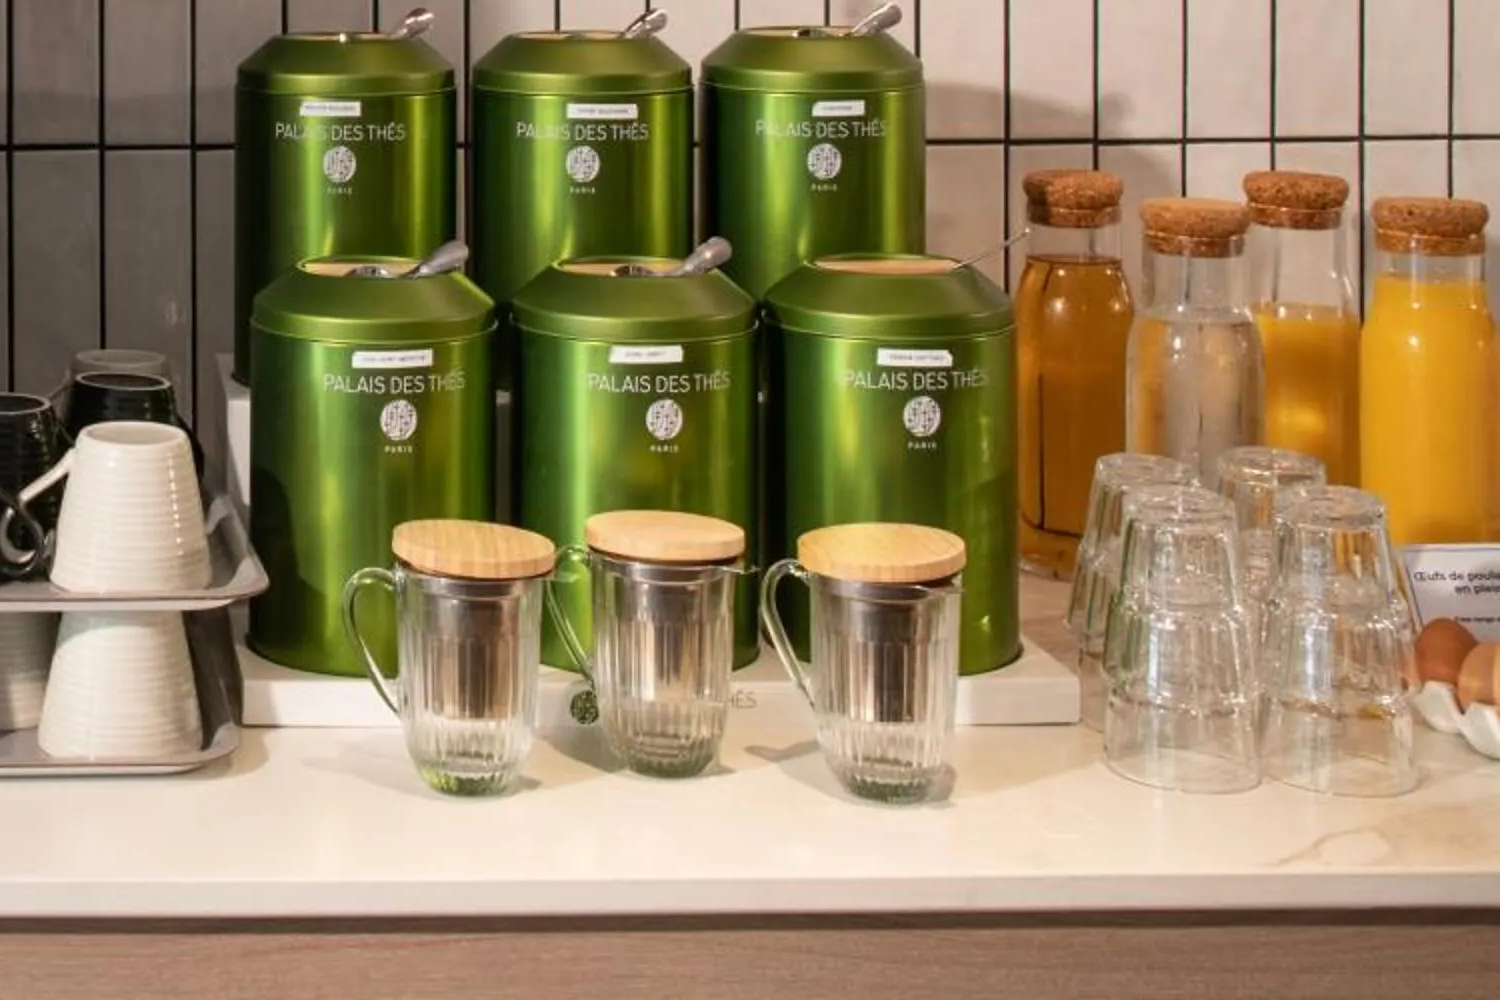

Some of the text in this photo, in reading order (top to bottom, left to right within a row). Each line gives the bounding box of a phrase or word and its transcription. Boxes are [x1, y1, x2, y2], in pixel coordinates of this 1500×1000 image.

[275, 121, 406, 141] PALS DES THÉS
[575, 123, 607, 141] DES
[755, 119, 812, 138] PAIS
[816, 121, 850, 138] DES
[323, 373, 385, 394] PALAIS
[390, 375, 425, 394] DES
[588, 369, 731, 393] PALAIS DES THÉS
[843, 368, 909, 391] PALAIS
[913, 371, 949, 391] DES
[1448, 570, 1464, 581] de
